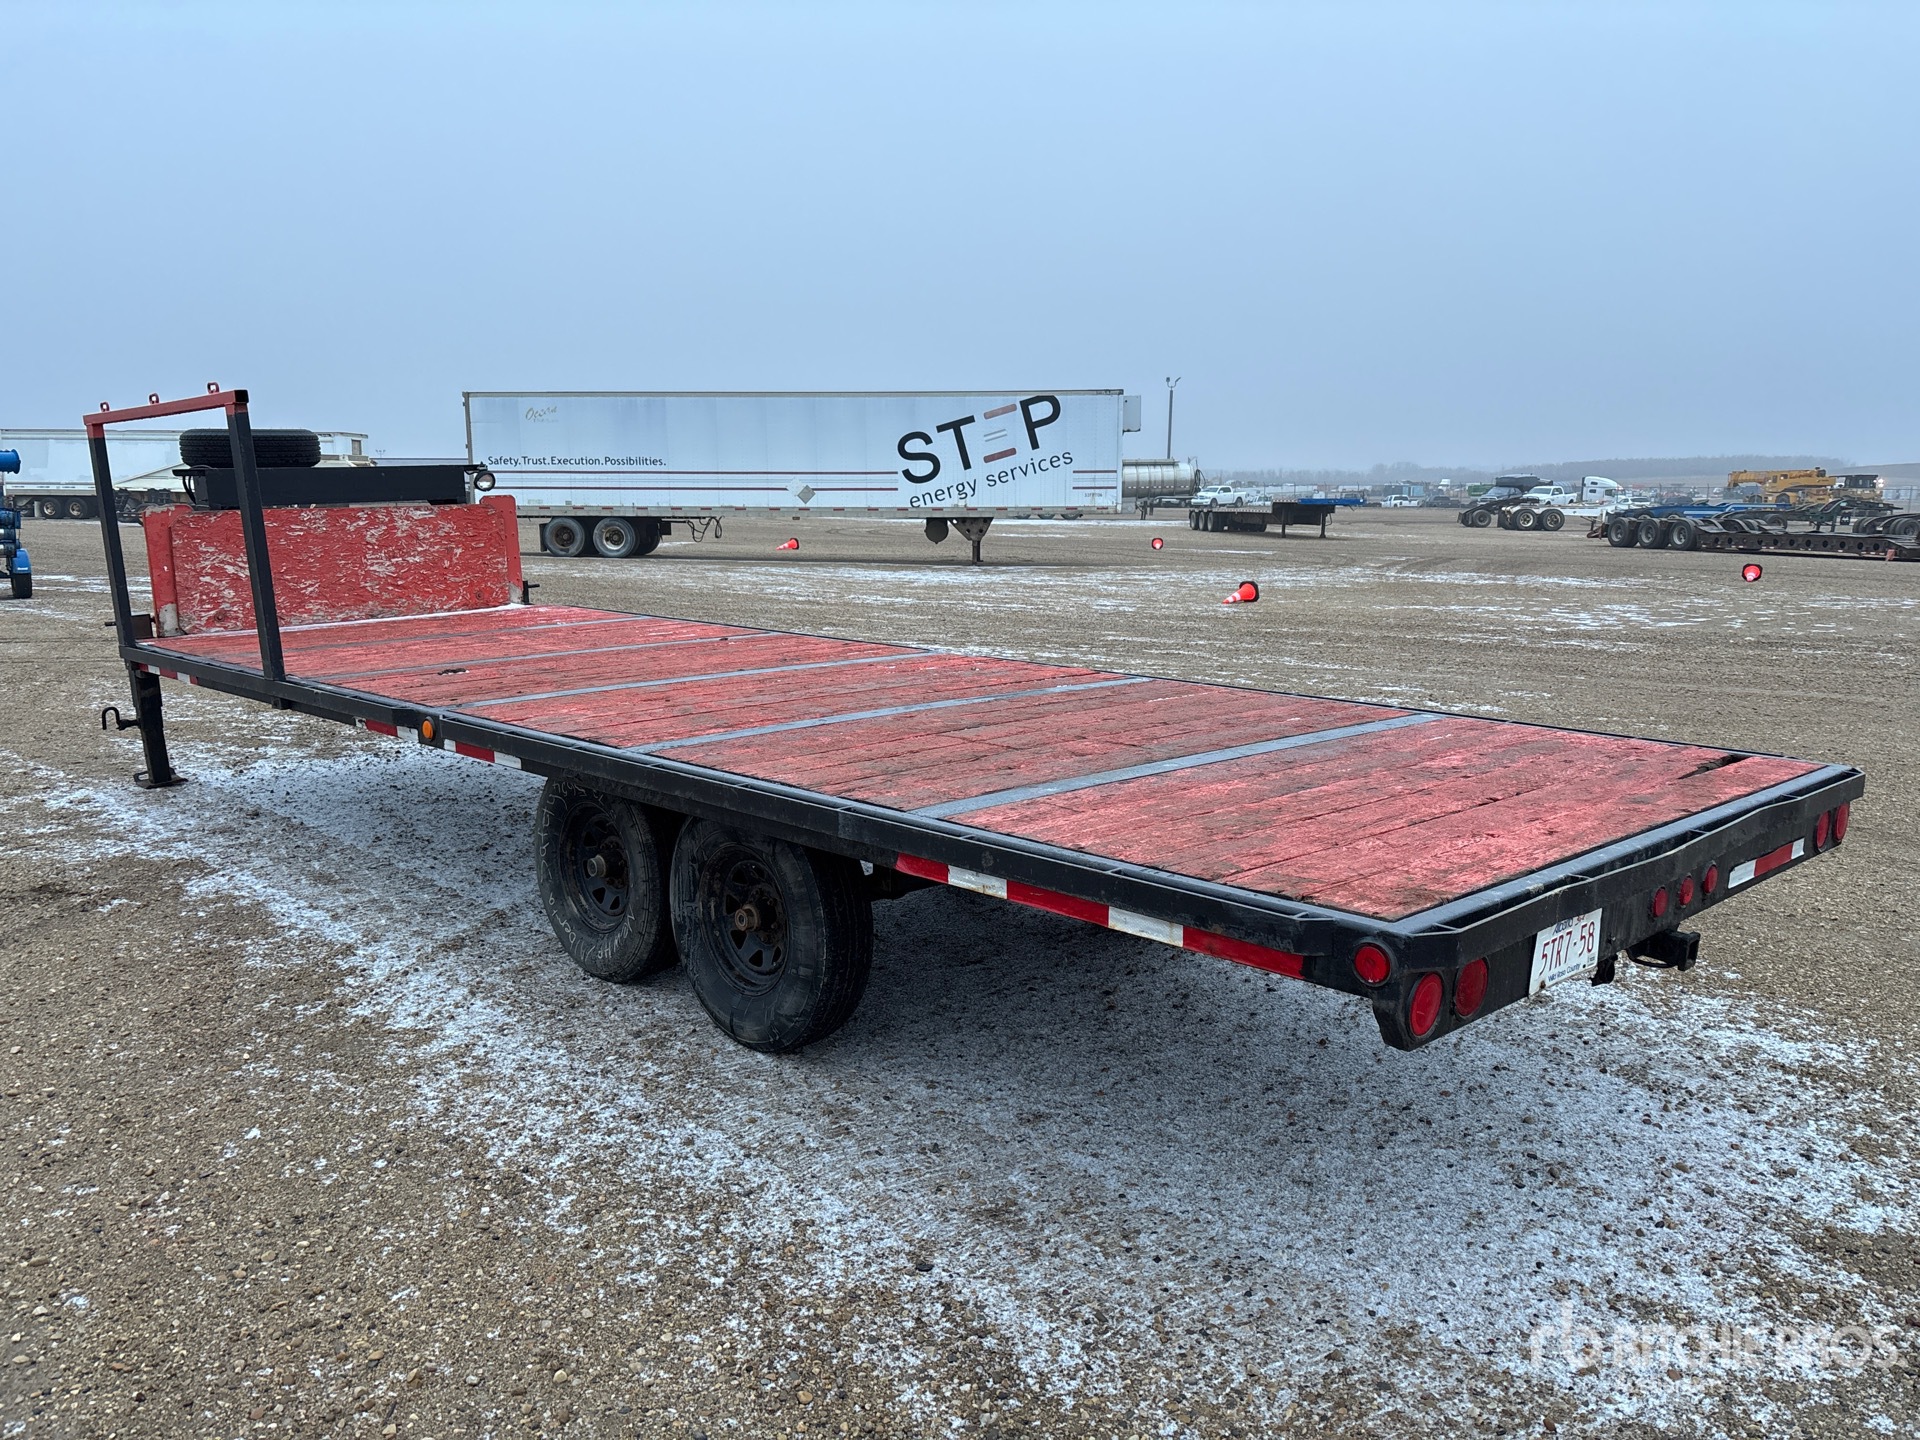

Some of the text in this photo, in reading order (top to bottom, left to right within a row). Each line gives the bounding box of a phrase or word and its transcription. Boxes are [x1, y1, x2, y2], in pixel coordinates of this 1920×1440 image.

[897, 395, 1062, 484] STEP
[909, 451, 1074, 508] energy services
